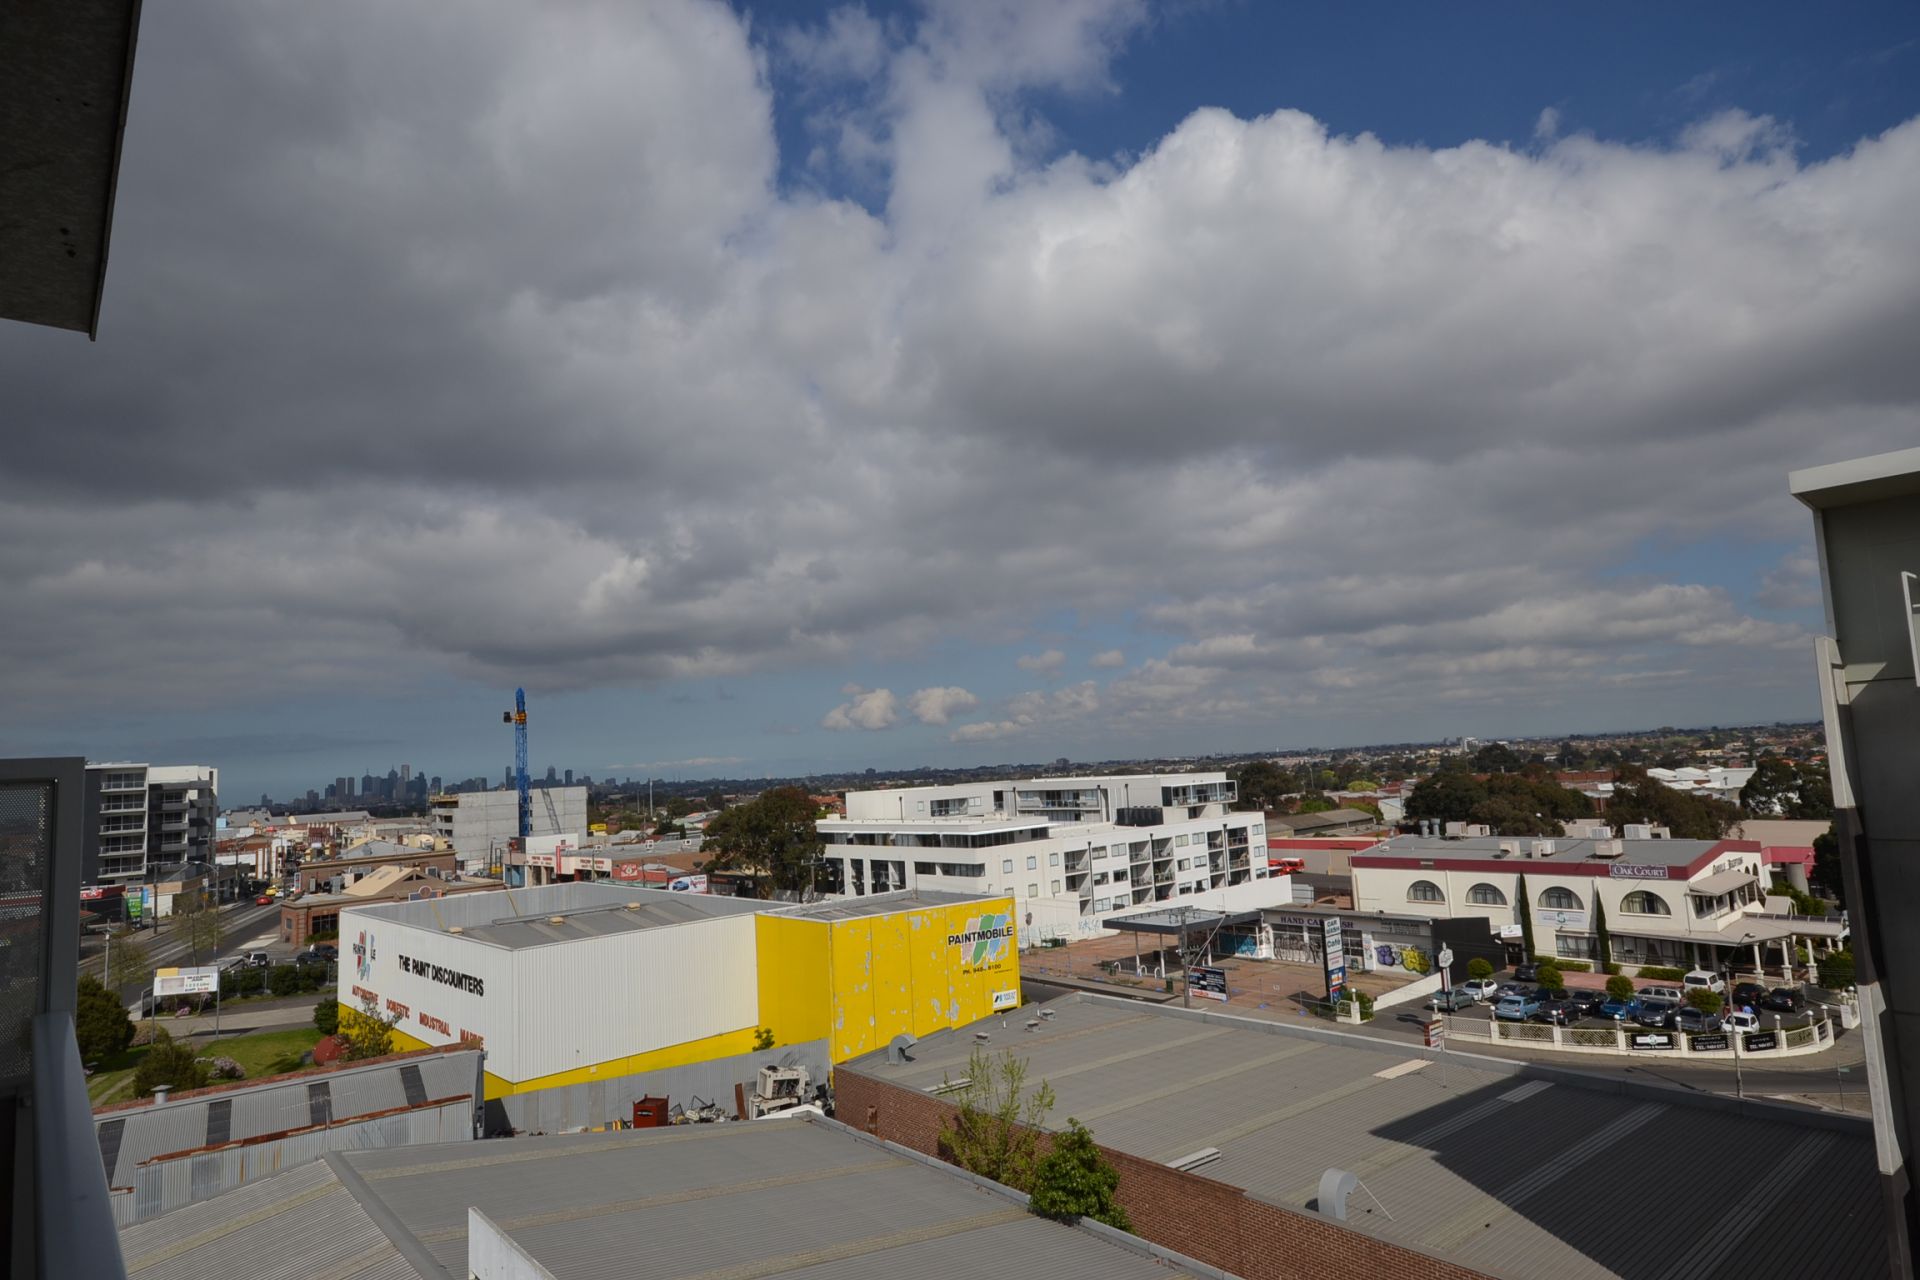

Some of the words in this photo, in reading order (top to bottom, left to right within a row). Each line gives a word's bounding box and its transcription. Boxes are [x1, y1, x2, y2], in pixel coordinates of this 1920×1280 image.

[1280, 916, 1304, 925] HAND
[948, 926, 1013, 946] PAINTMOBILE
[399, 954, 411, 972] THE
[412, 958, 430, 979] PAINT
[432, 964, 484, 997] DISCOUNTERS
